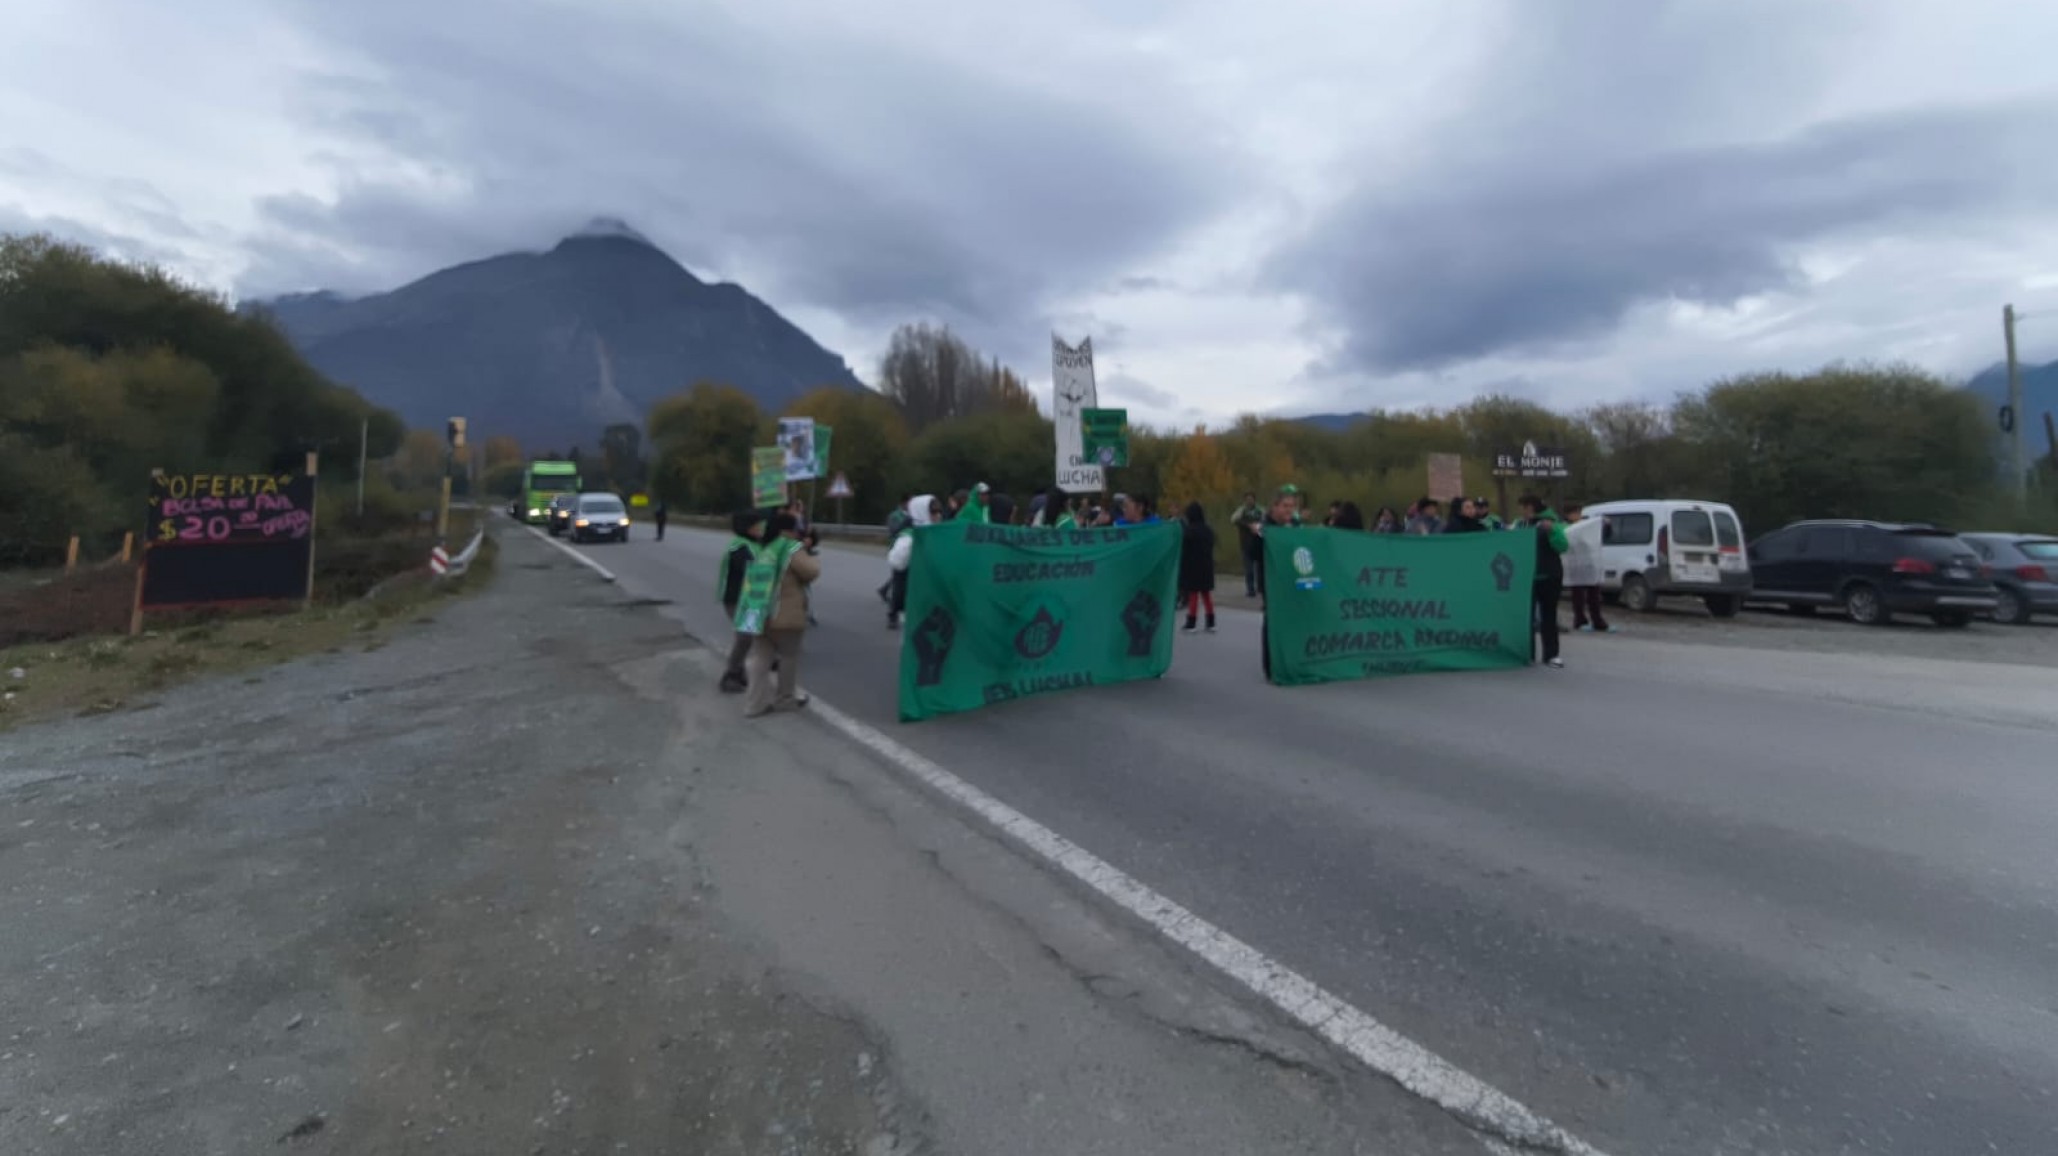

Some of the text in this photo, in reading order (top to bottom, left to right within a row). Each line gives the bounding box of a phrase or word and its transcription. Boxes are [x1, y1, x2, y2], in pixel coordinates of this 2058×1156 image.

[1498, 454, 1564, 470] EL MONJE
[1068, 528, 1095, 546] DE
[1102, 528, 1129, 543] LA
[993, 555, 1095, 583] EDUCACIÓN
[1356, 566, 1408, 588] ATE
[1305, 630, 1406, 656] COMARCA
